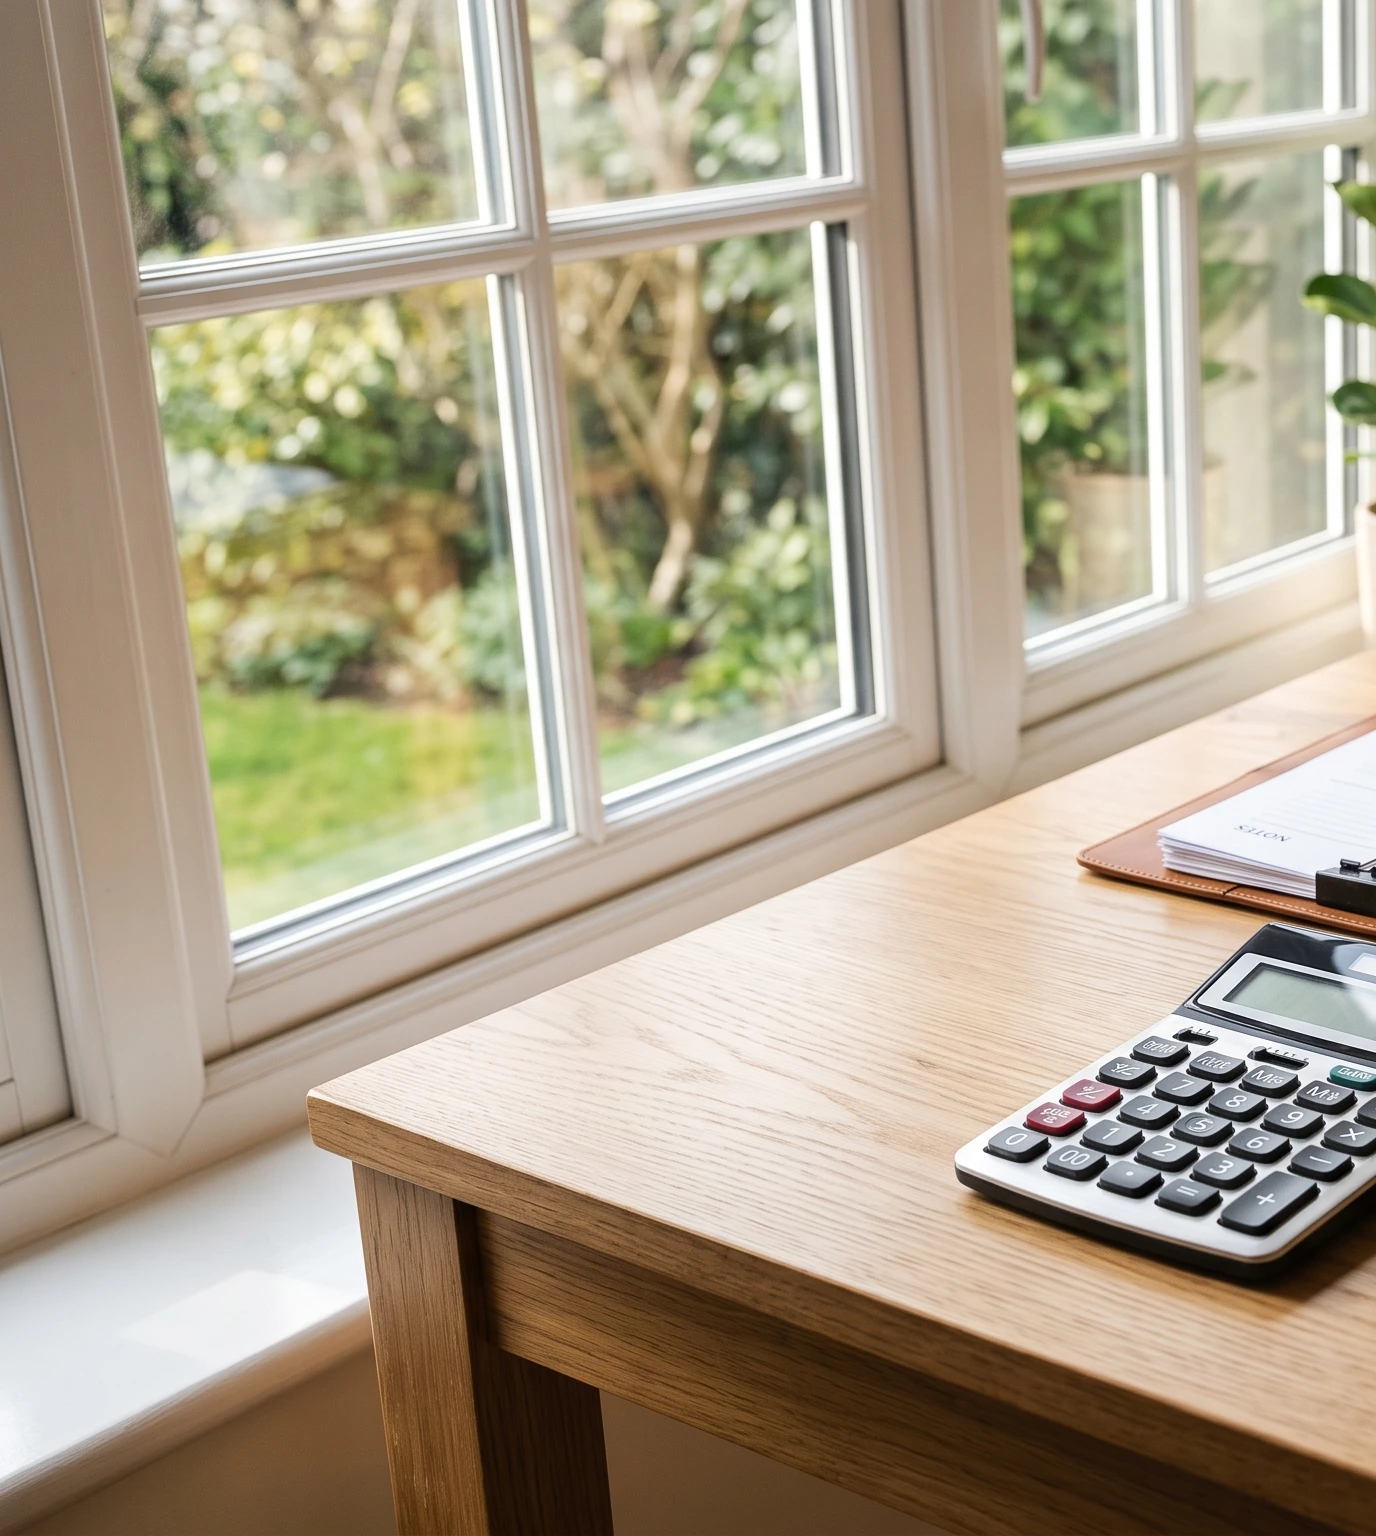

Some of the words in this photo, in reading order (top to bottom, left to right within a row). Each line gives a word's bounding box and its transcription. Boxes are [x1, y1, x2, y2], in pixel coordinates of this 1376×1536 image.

[1172, 1079, 1195, 1091] 7
[1225, 1095, 1248, 1108] 8
[1136, 1103, 1159, 1115] 4
[1280, 1111, 1304, 1124] 9
[1192, 1118, 1214, 1131] 5
[1005, 1133, 1028, 1145] 0
[1102, 1127, 1120, 1140] 1
[1246, 1136, 1269, 1149] 6
[1152, 1143, 1176, 1157] 2
[1059, 1150, 1091, 1165] 00
[1209, 1160, 1234, 1174] 3
